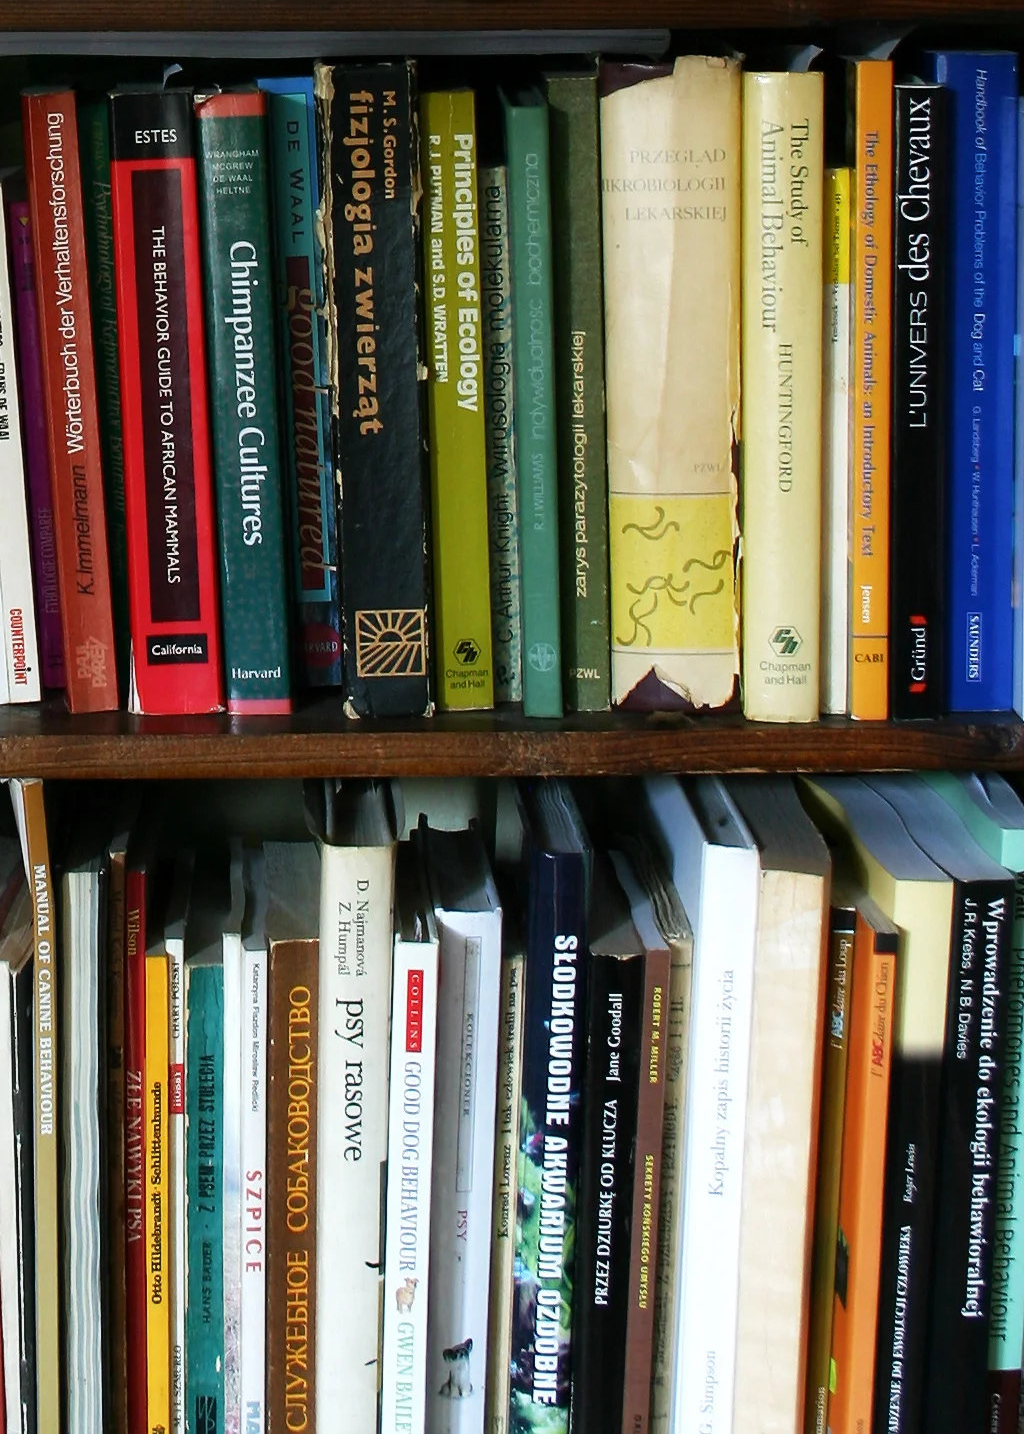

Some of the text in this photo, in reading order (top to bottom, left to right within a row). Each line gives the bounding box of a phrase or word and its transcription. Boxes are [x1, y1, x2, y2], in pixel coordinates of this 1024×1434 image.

[134, 130, 179, 144] ESTES
[761, 120, 782, 332] Animal Behaviour
[786, 119, 809, 245] The Study of
[45, 113, 84, 454] Wörterbuch der Verhaltensforschung
[348, 92, 382, 435] fizjologia zwierząt
[454, 134, 480, 412] Principles of Ecology
[150, 226, 180, 583] THE BEHAVIOR GUIDE TO AFRICAN MAMMALS
[229, 241, 264, 546] Chimpanzee Cultures
[778, 344, 793, 493] HUNTINGFORD
[150, 644, 202, 656] California
[231, 666, 281, 679] Harvard
[969, 615, 980, 678] SAUNDERS
[335, 997, 364, 1161] psy rasowe
[411, 975, 419, 1048] COLLINS
[961, 898, 1004, 1317] Wprowadzenie do ekologii behawioralnej
[287, 986, 316, 1431] СЛУЖЕБНОЕ СОБАКОВОДСТВО
[594, 994, 623, 1305] PRZEZ DZIURKĘ OD KLUCZA Jane Goodall
